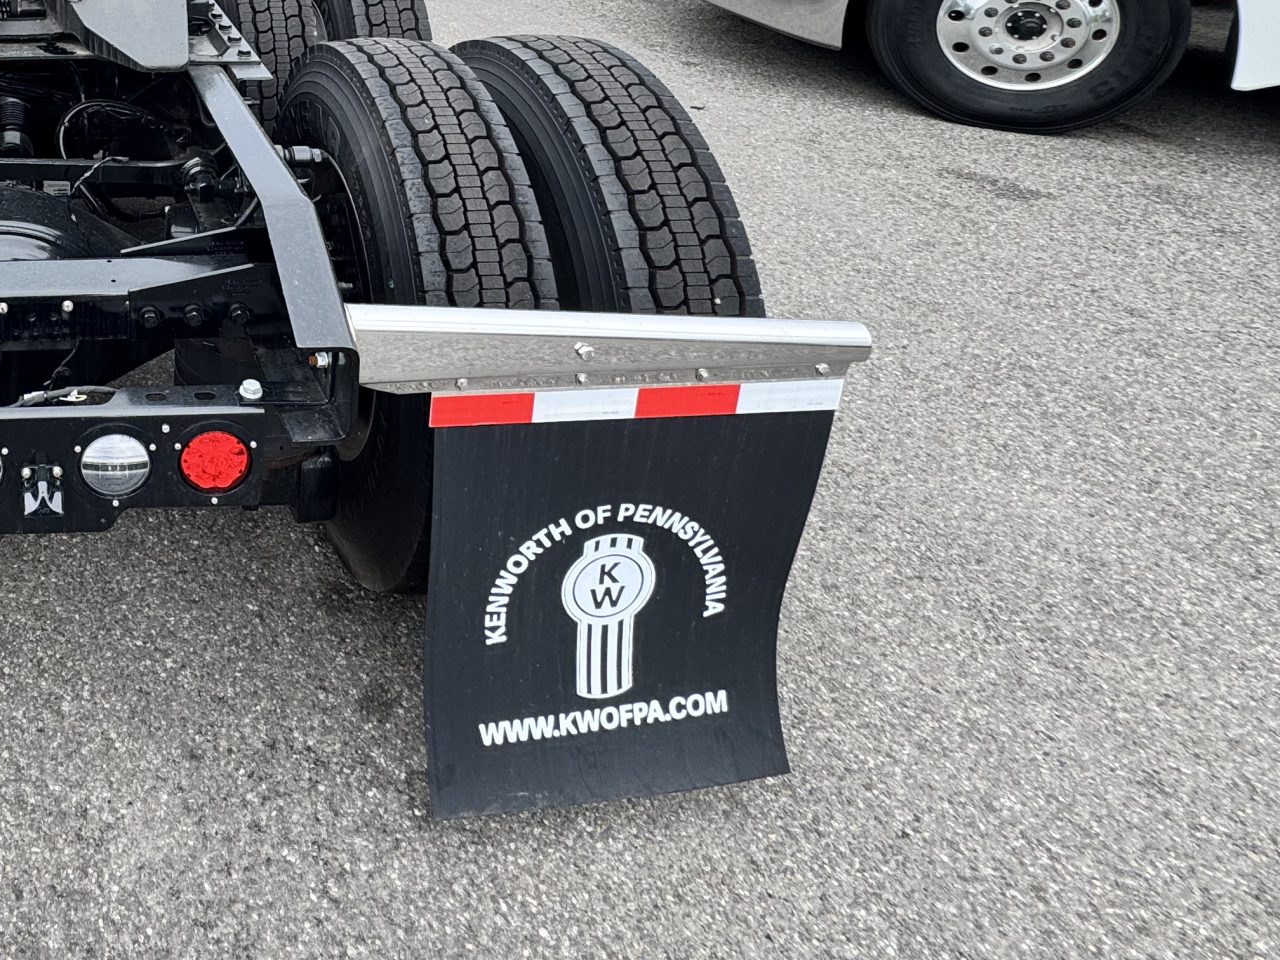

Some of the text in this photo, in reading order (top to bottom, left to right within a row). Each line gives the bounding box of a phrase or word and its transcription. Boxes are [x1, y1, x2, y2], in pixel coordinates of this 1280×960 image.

[485, 503, 728, 646] KENWORTH OF PENNSYLVANIA
[478, 689, 729, 747] WWW.KWOFPA.COM
